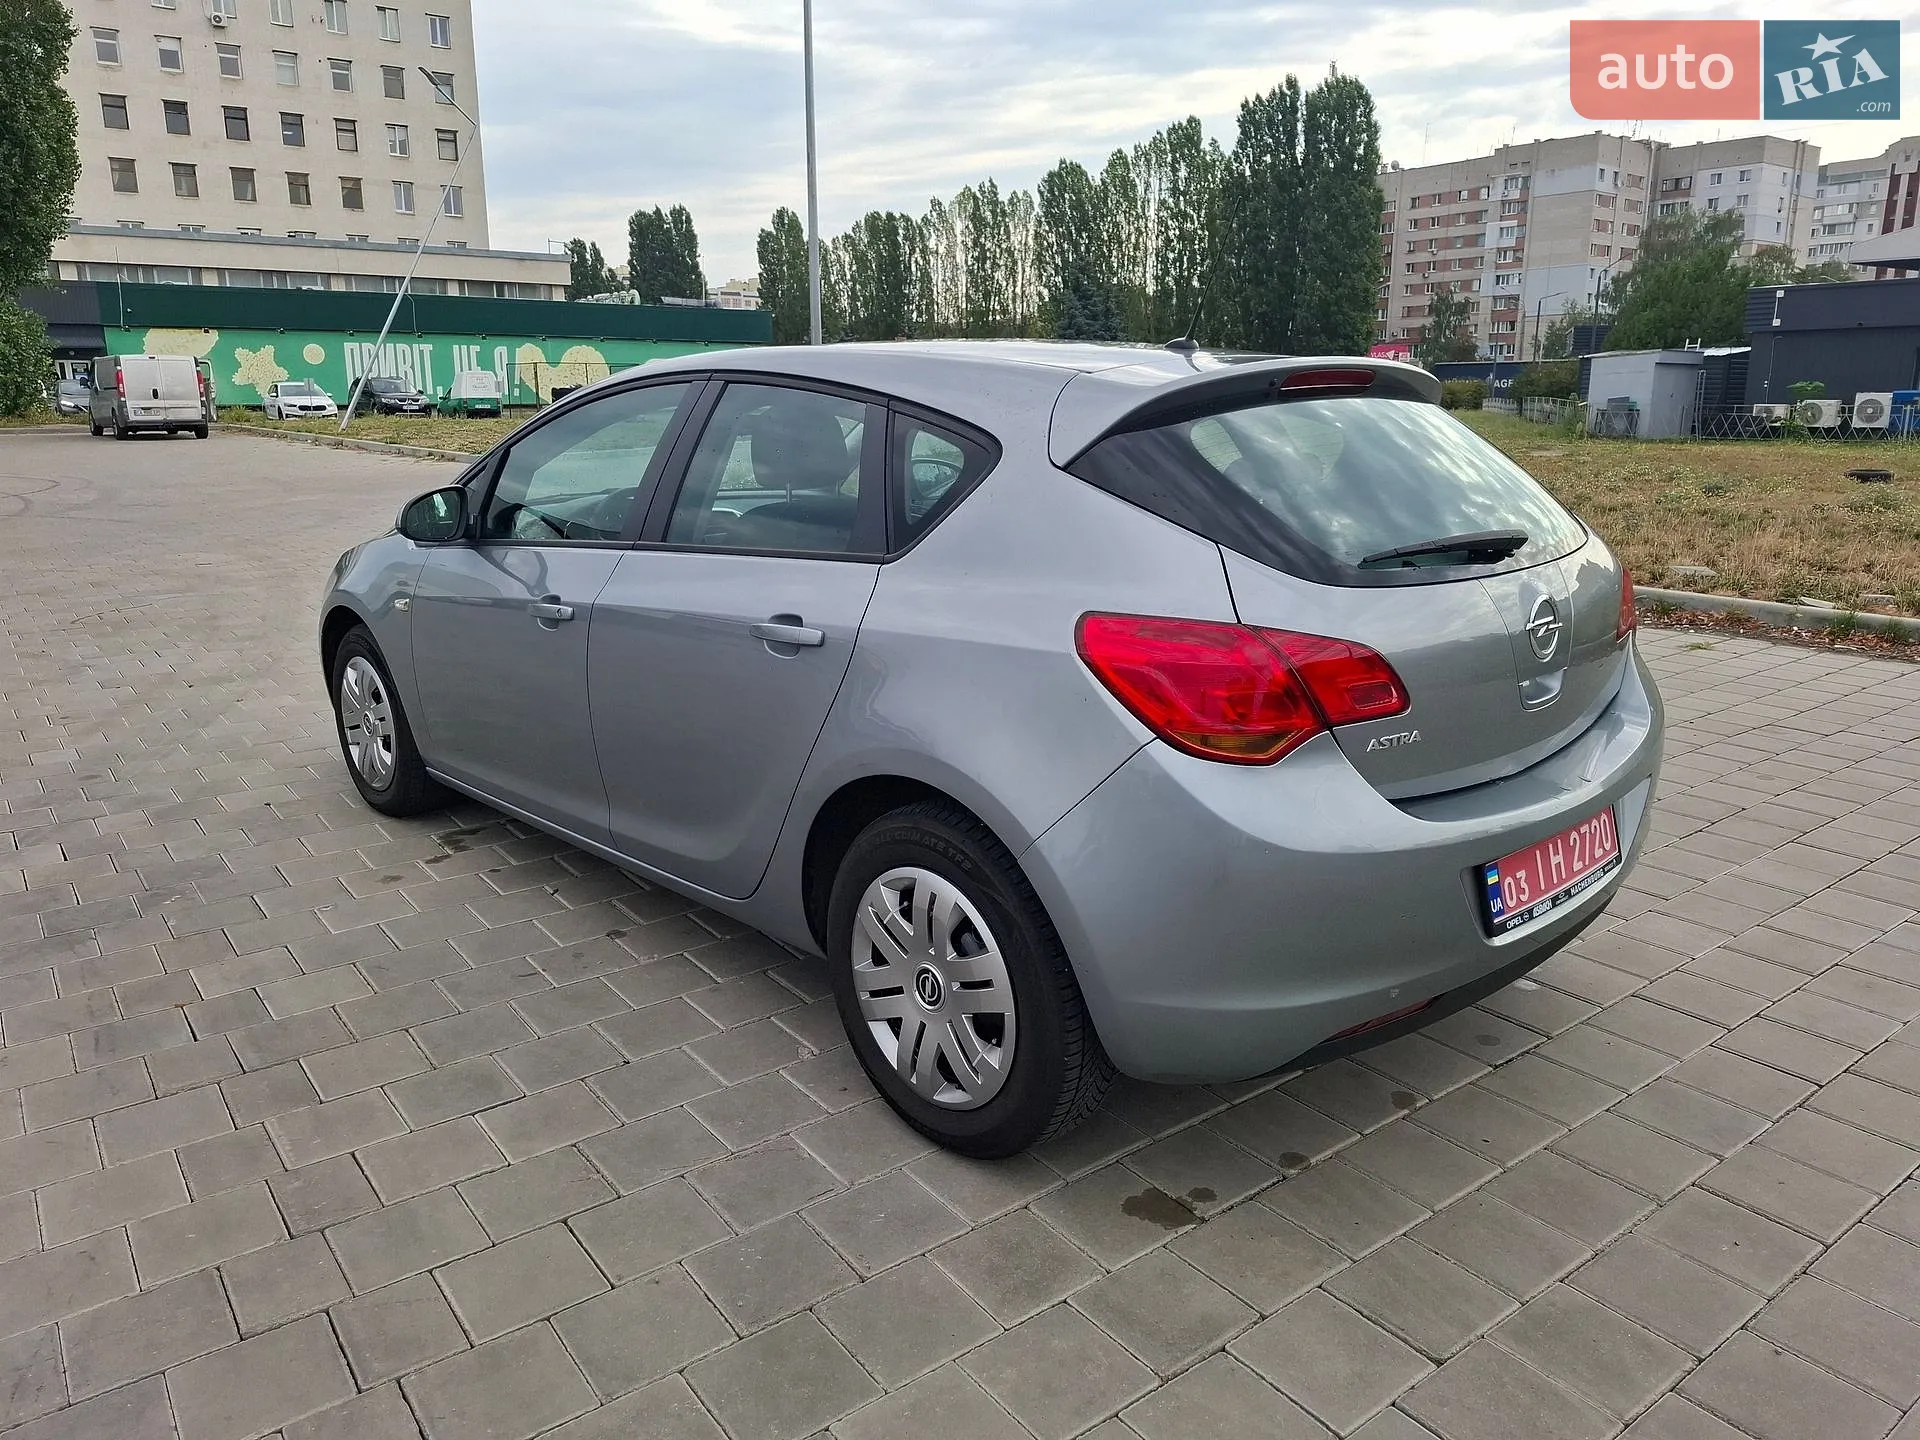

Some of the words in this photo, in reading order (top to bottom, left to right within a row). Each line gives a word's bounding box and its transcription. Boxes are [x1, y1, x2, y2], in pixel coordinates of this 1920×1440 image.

[1366, 730, 1422, 753] ASTRA
[1504, 869, 1529, 908] 03
[1569, 812, 1611, 872] 2720
[1490, 897, 1503, 913] UA
[1506, 916, 1523, 929] OPEL
